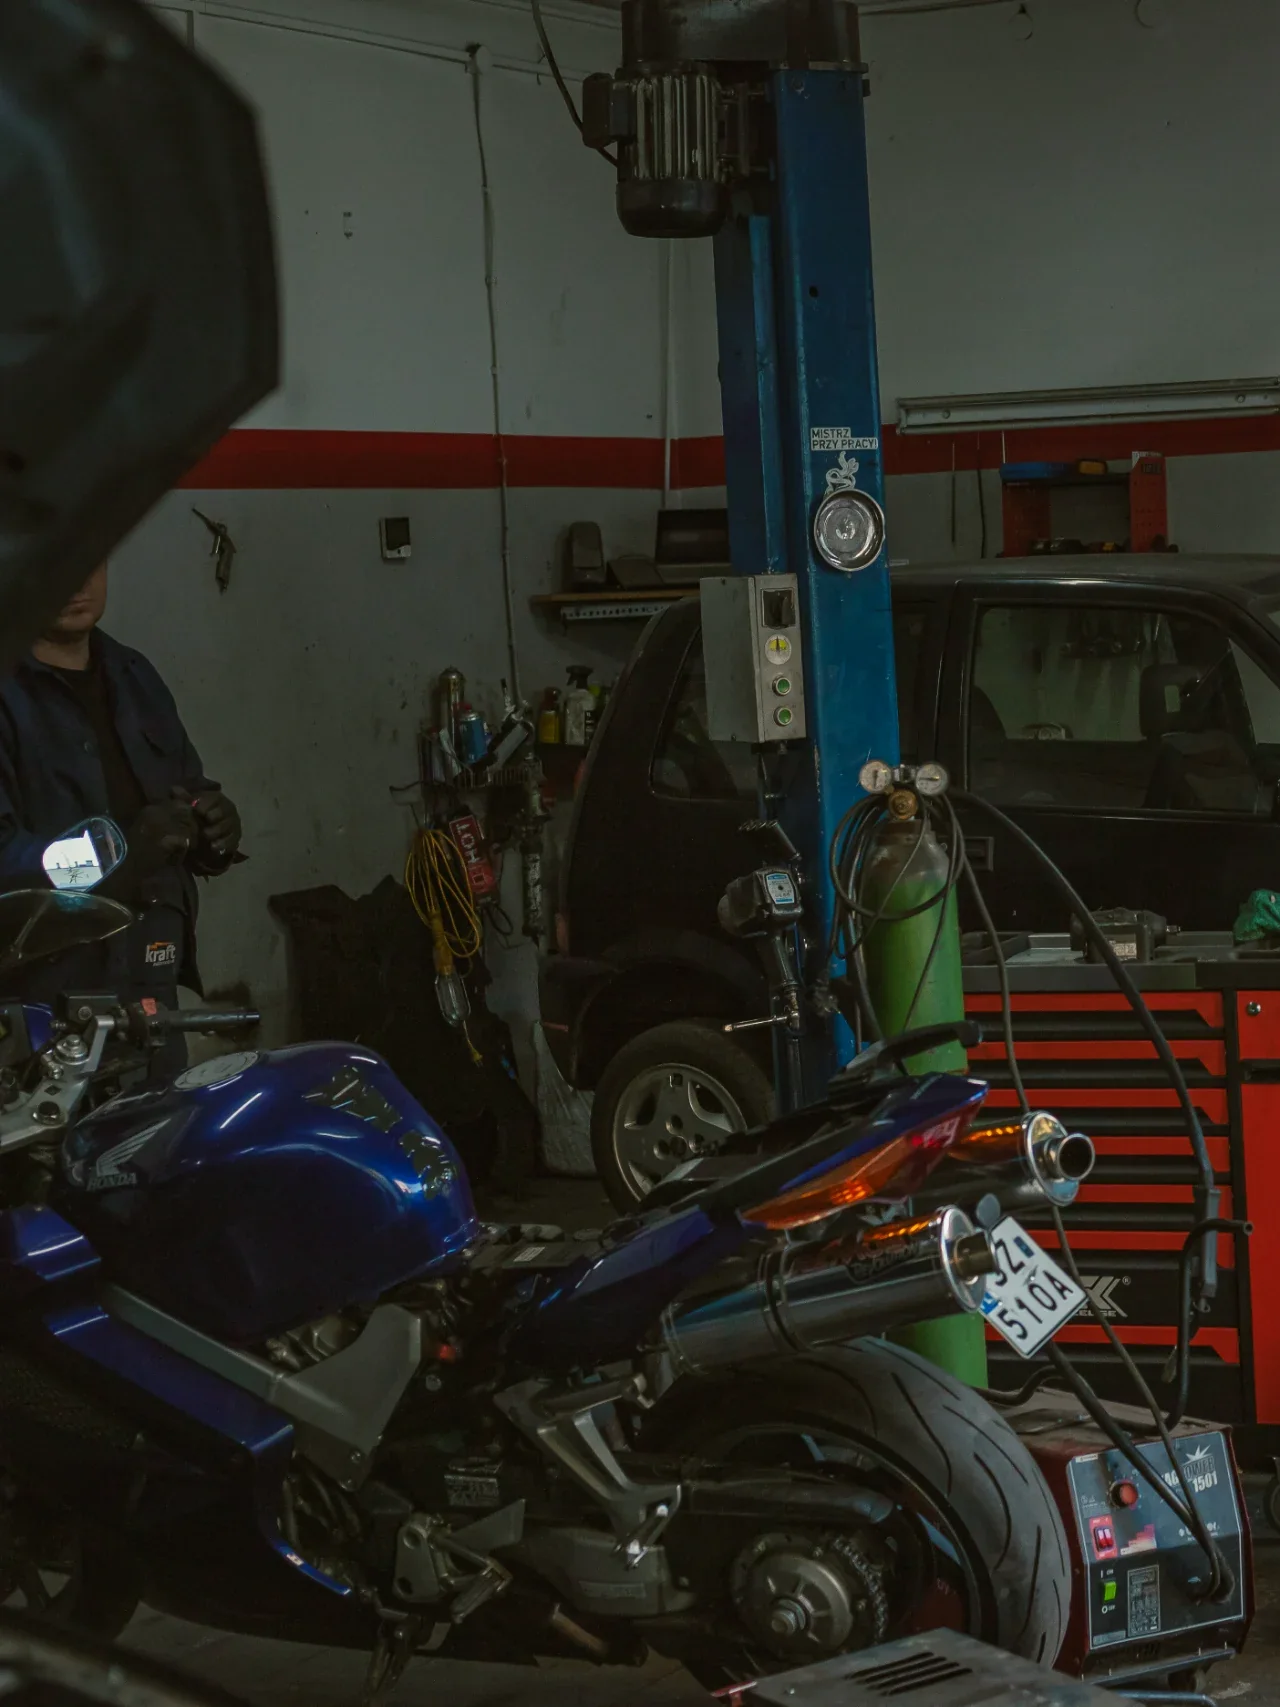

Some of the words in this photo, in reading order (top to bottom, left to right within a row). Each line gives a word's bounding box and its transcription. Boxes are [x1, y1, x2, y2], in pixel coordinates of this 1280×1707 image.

[812, 428, 850, 439] MISTRZ
[812, 439, 839, 449] PRZY
[841, 438, 877, 449] PRACY!
[145, 944, 176, 963] kraft
[86, 1172, 137, 1191] HONDA
[997, 1269, 1074, 1340] 510A
[1192, 1470, 1218, 1493] 1501
